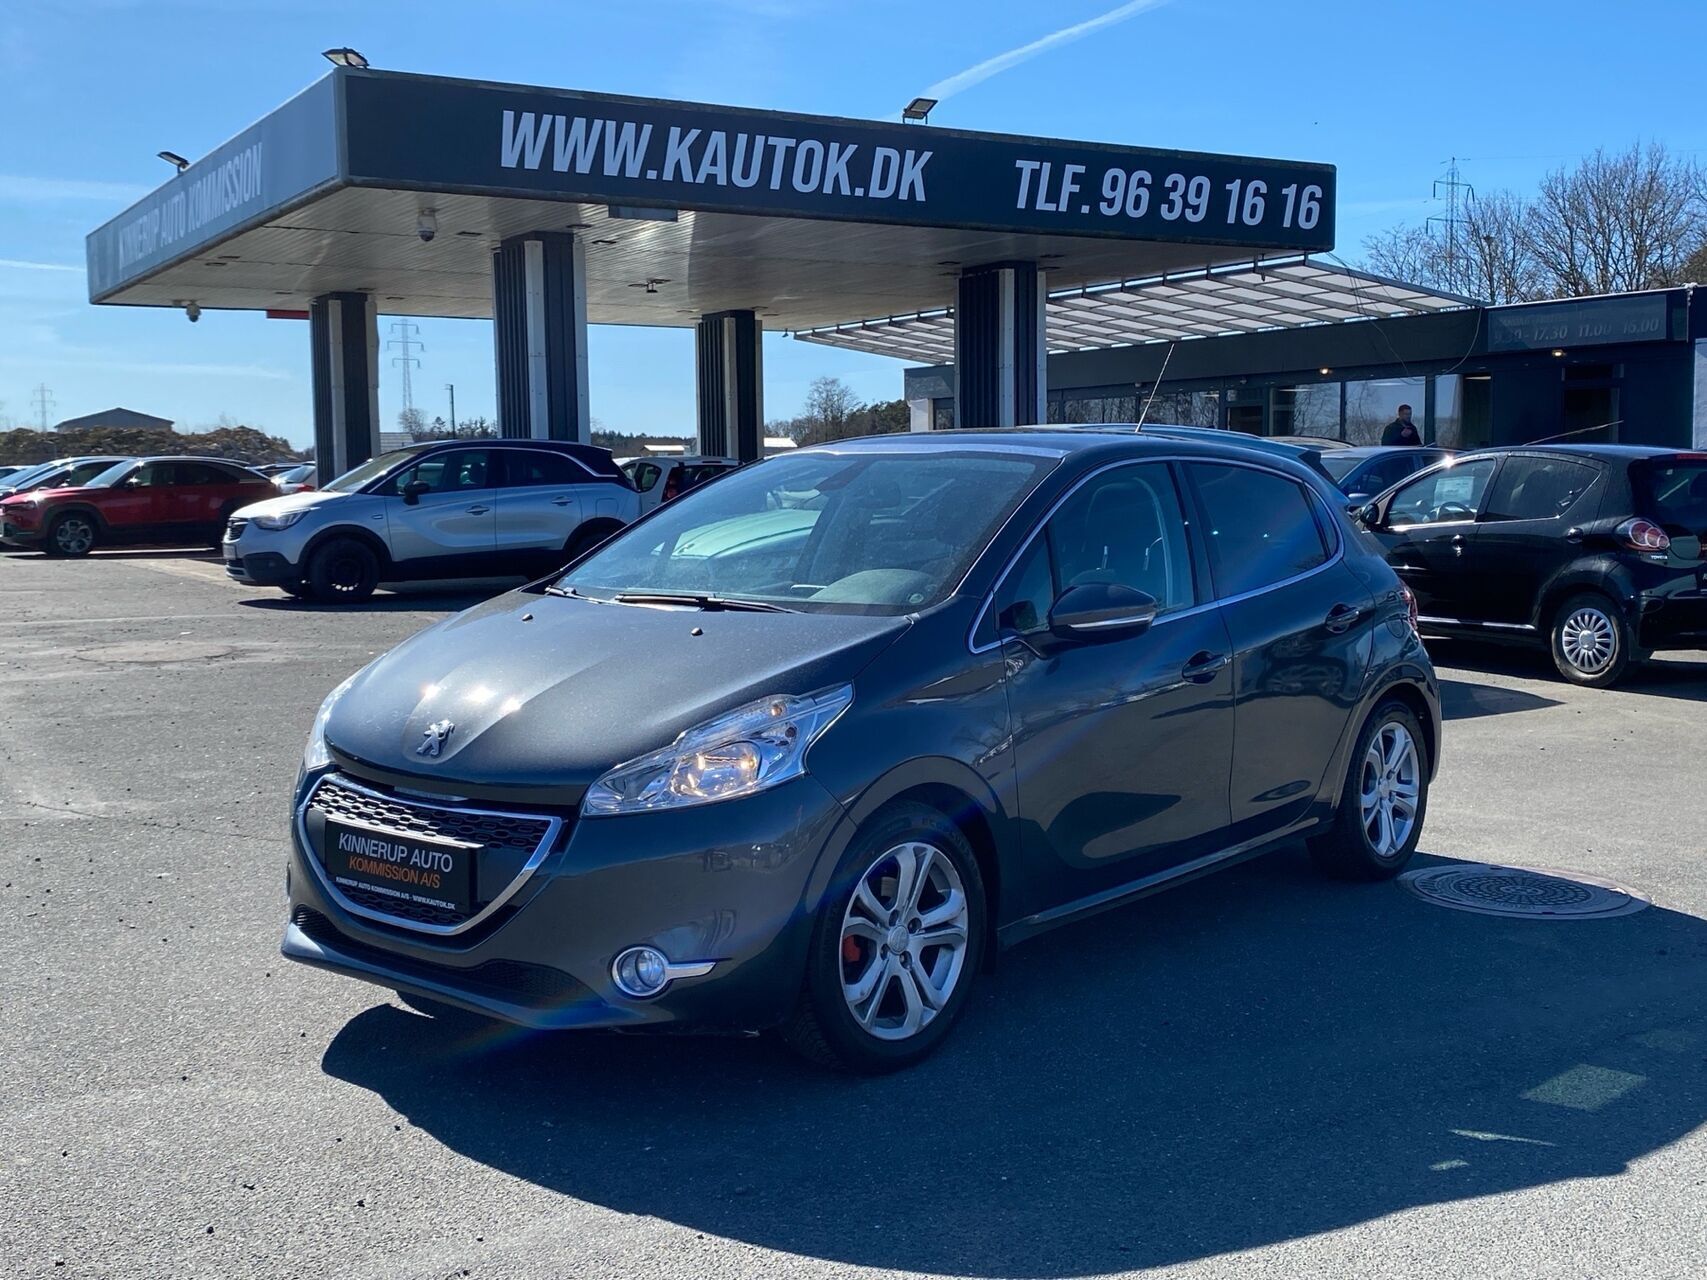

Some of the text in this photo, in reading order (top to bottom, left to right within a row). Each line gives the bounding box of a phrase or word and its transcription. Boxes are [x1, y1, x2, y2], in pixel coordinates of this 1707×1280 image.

[500, 110, 933, 202] WWW.KAUTOK.DK
[161, 191, 186, 248] AUTO
[187, 141, 263, 233] KOMMISSION
[1015, 159, 1323, 230] TLF. 96 39 16 16
[338, 832, 453, 873] KINNERUP AUTO
[348, 856, 441, 889] KOMMISSION A/S
